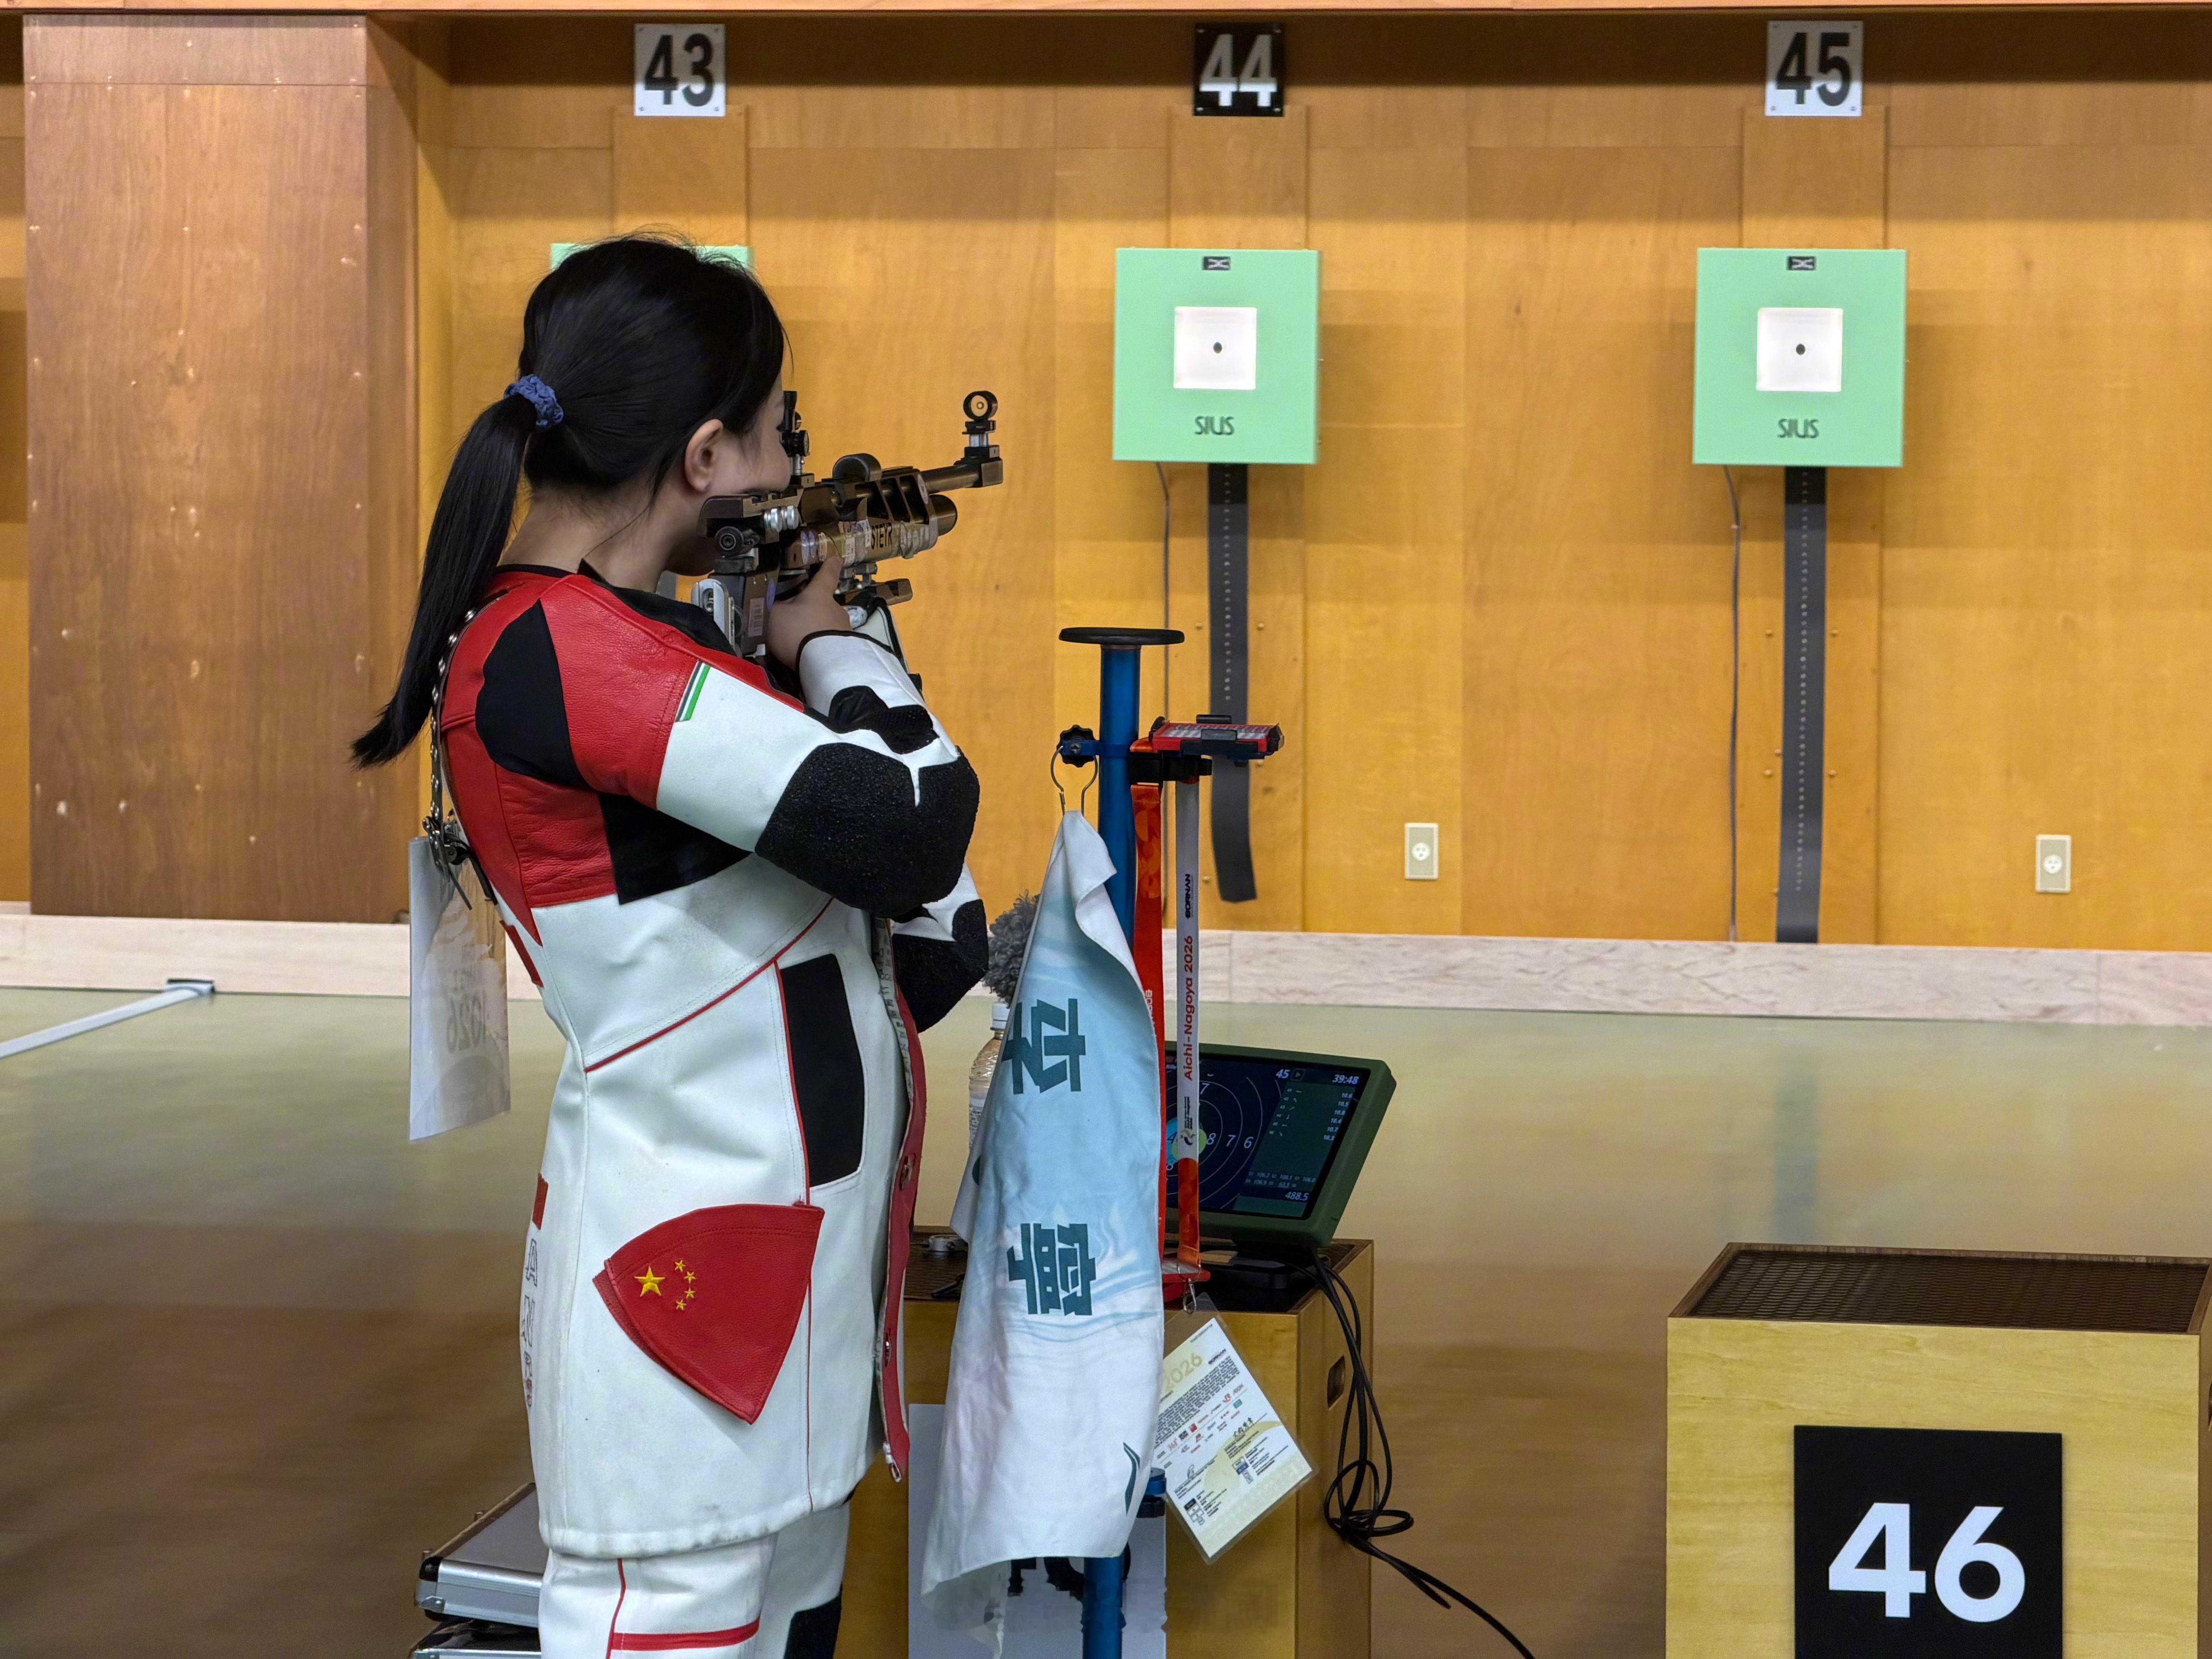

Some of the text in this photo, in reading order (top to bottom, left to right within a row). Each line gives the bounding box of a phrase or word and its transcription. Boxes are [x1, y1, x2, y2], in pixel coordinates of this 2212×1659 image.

[644, 33, 715, 107] 43
[1199, 33, 1278, 107] 44
[1776, 31, 1851, 106] 45
[1194, 416, 1235, 435] SIUS
[1777, 419, 1820, 438] SIUS
[871, 522, 892, 550] STEYR
[1183, 935, 1195, 1081] Aichi-Nagoya 2026
[1200, 1083, 1210, 1095] 7
[1276, 1069, 1359, 1085] 45 39:48
[1207, 1132, 1254, 1149] 8 7 6
[1285, 1191, 1309, 1201] 488.5
[1162, 1352, 1202, 1391] 2026
[1828, 1502, 2025, 1623] 46
